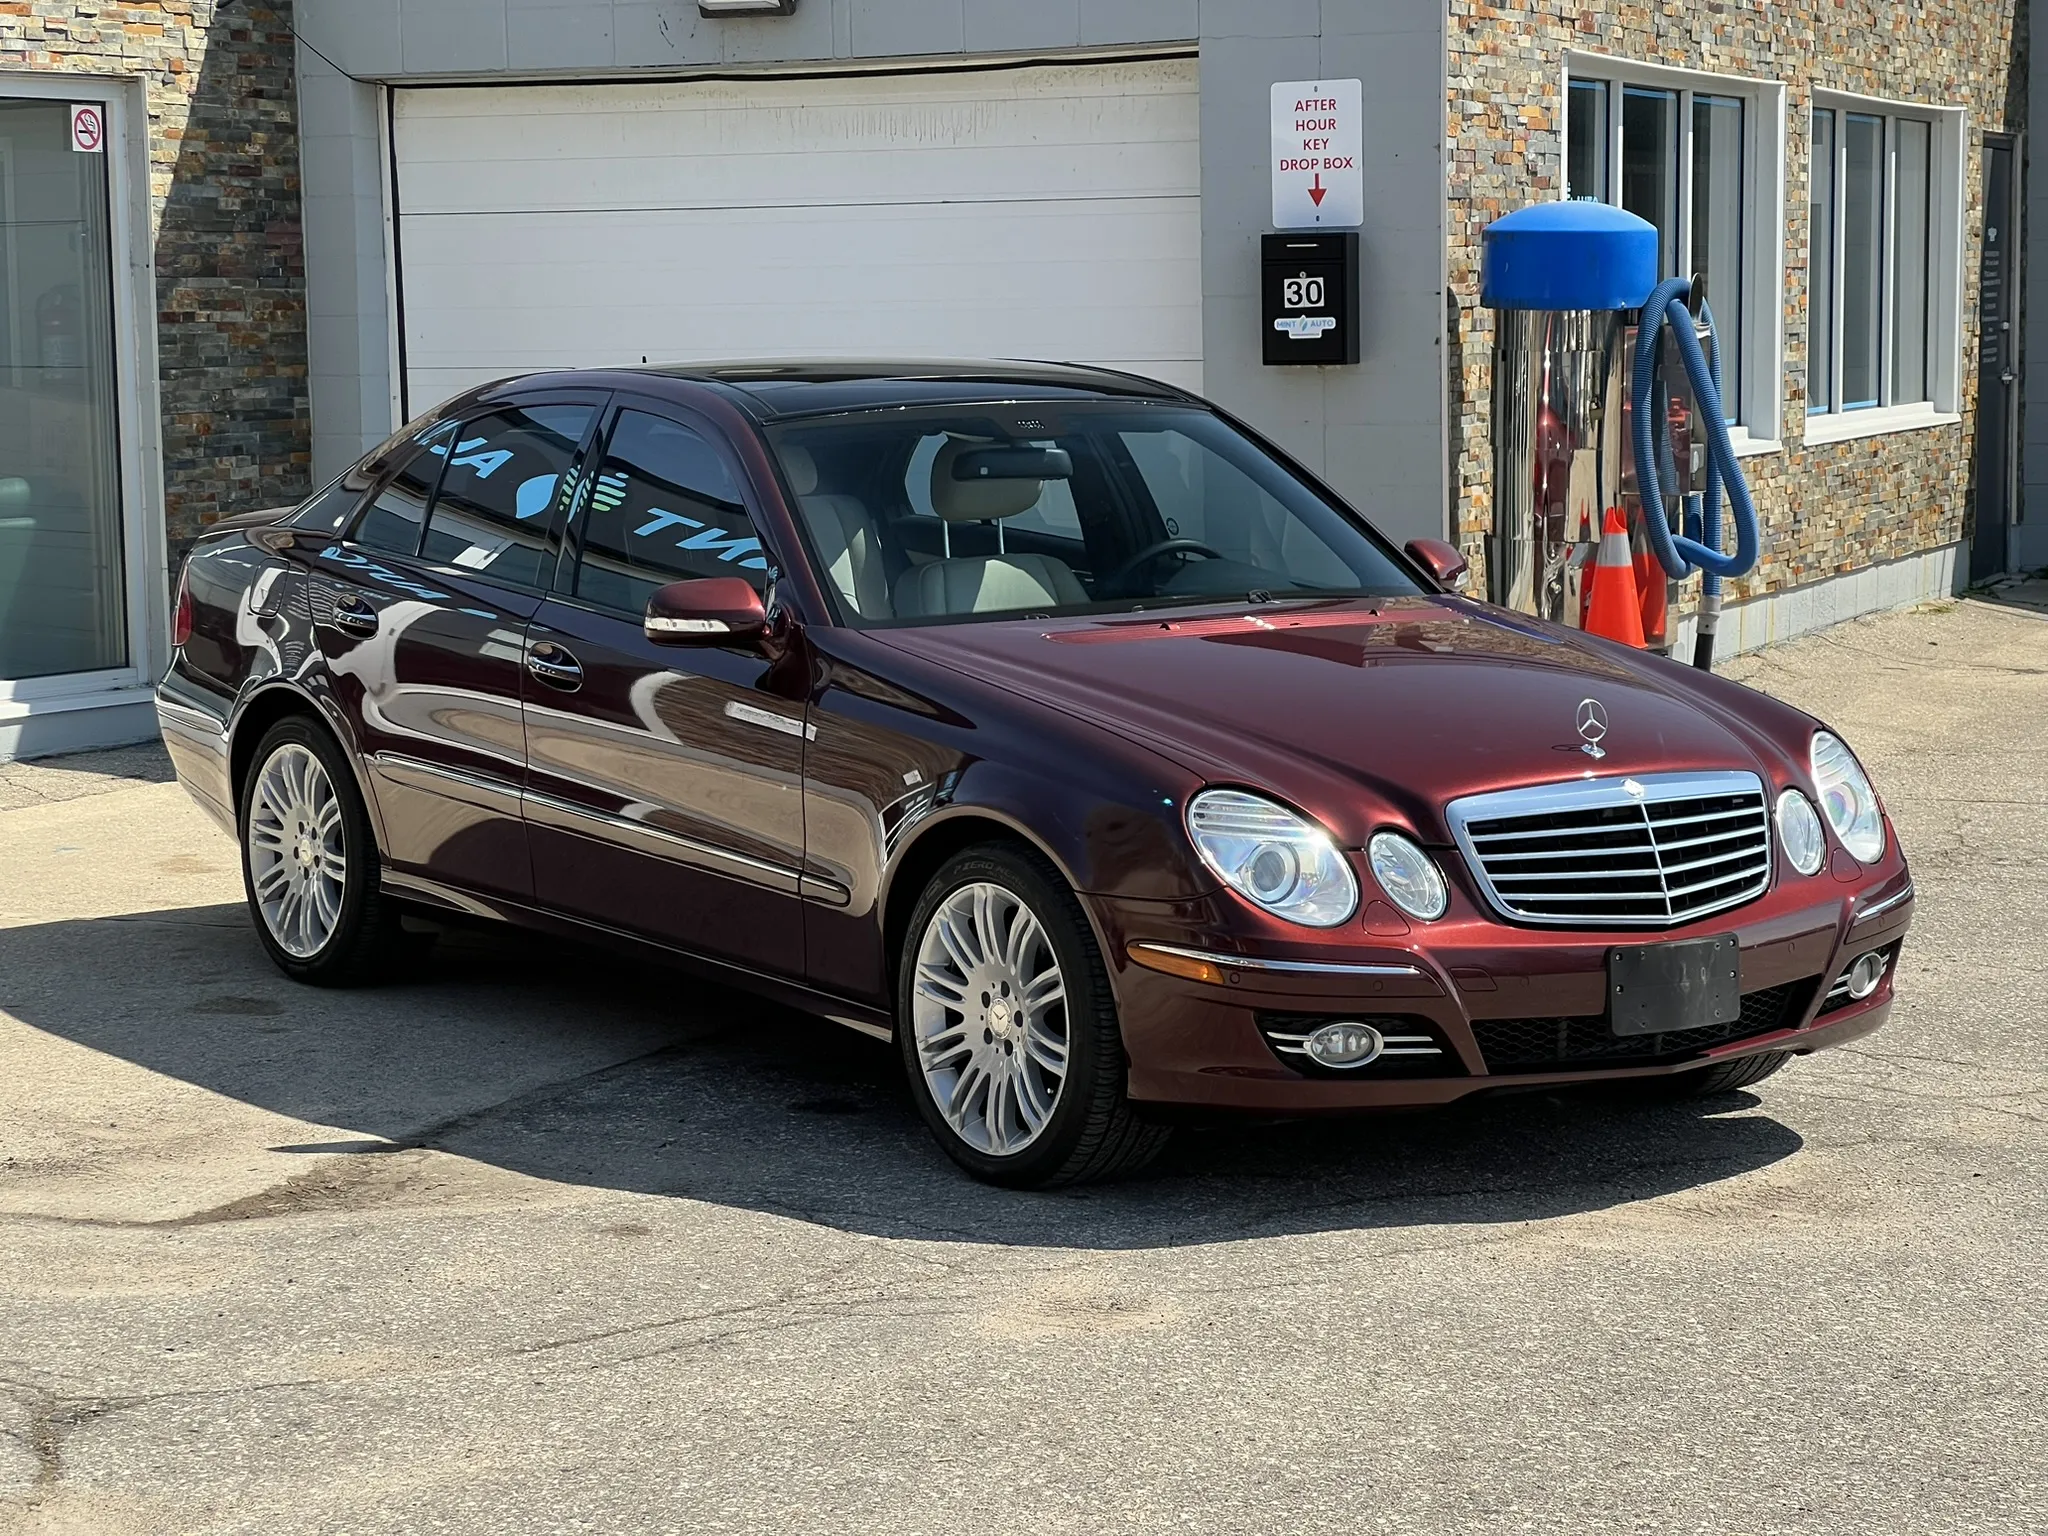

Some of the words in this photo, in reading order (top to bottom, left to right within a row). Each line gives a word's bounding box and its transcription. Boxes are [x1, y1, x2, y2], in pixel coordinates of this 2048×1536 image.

[1294, 98, 1337, 112] AFTER
[1295, 118, 1337, 132] HOUR
[1303, 138, 1330, 151] KEY
[1280, 158, 1319, 171] DROP
[1323, 157, 1354, 169] BOX
[1286, 280, 1323, 306] 30
[1276, 320, 1297, 329] MINT
[1310, 319, 1334, 328] AUTO
